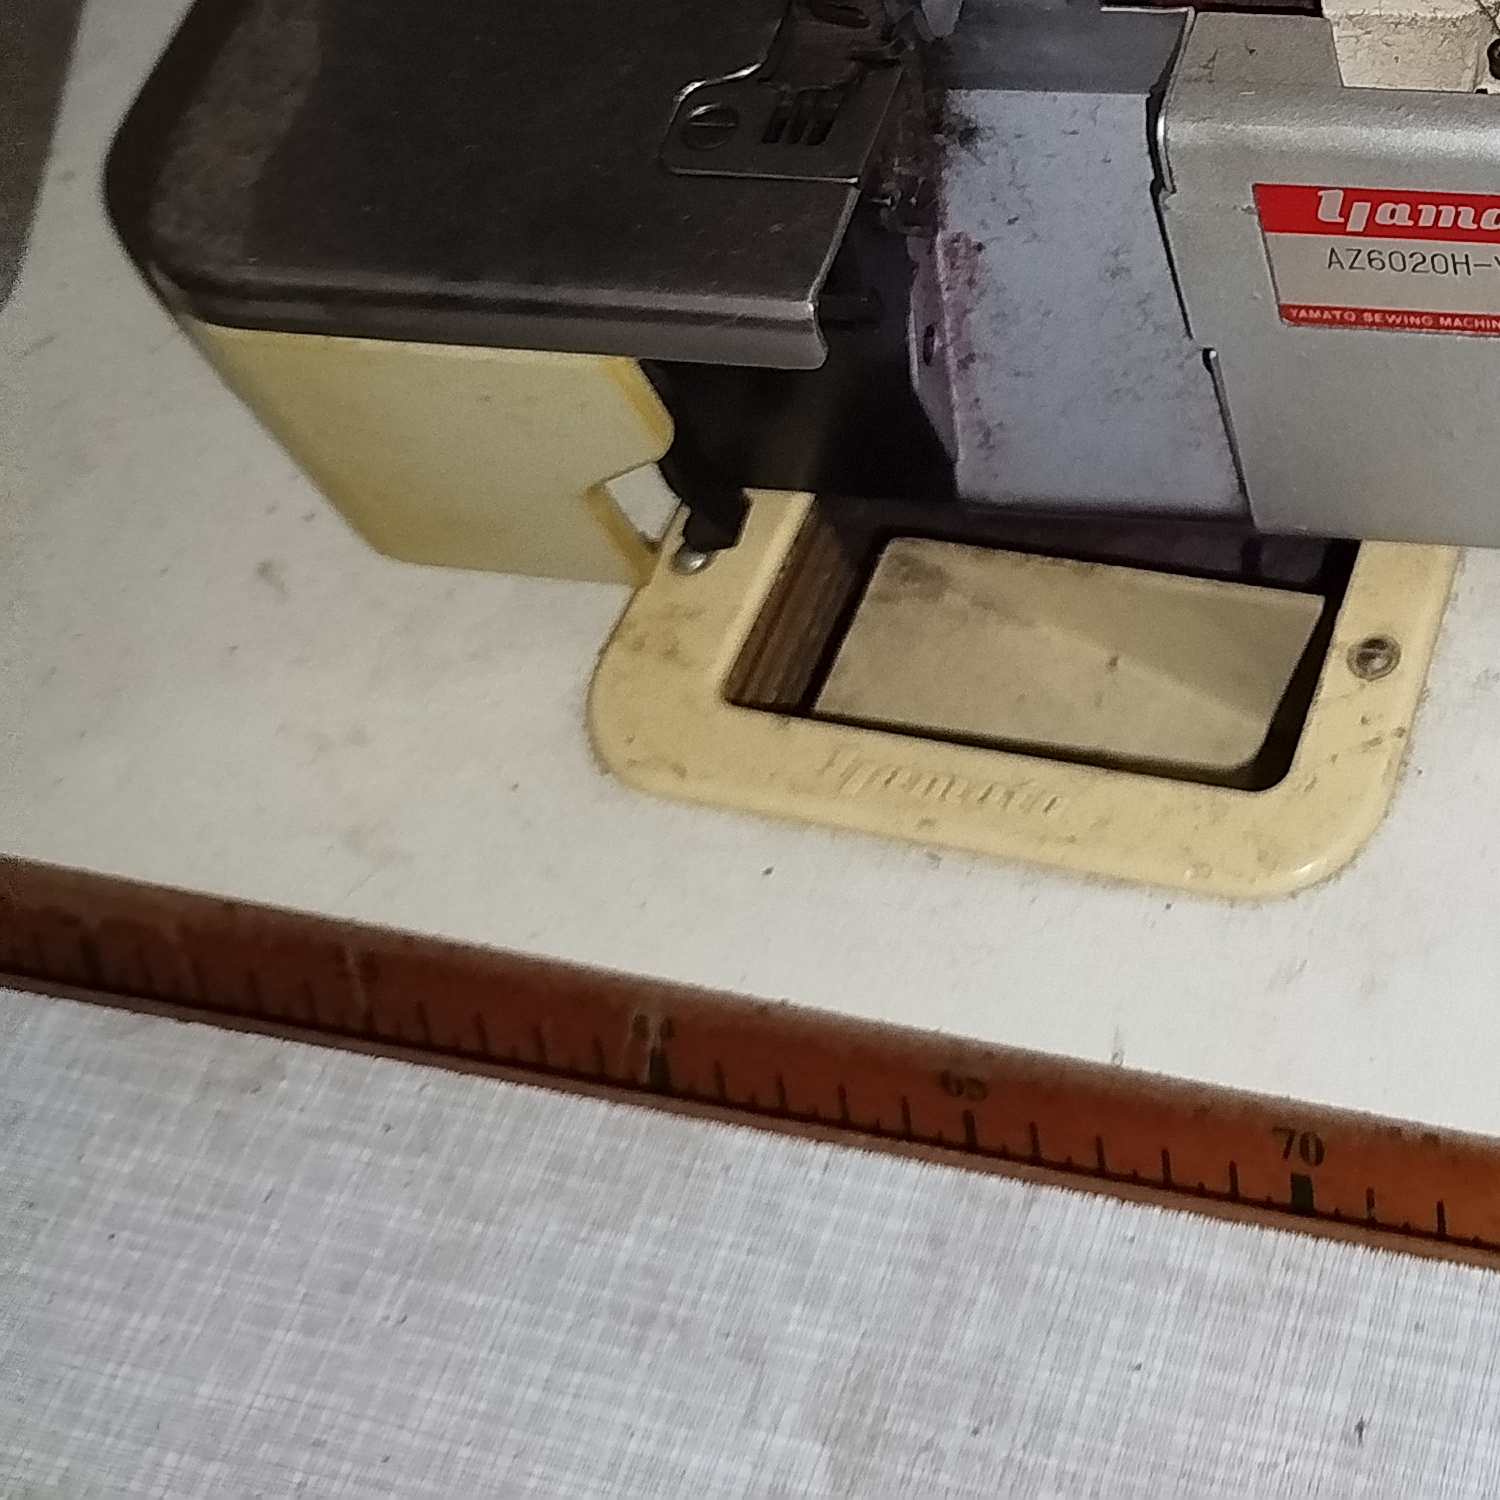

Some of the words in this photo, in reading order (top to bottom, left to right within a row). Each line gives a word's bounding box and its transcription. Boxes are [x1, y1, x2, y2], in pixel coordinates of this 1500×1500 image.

[1289, 308, 1357, 323] YAMATO
[1362, 312, 1433, 327] SEWING
[1273, 1126, 1325, 1167] 70
